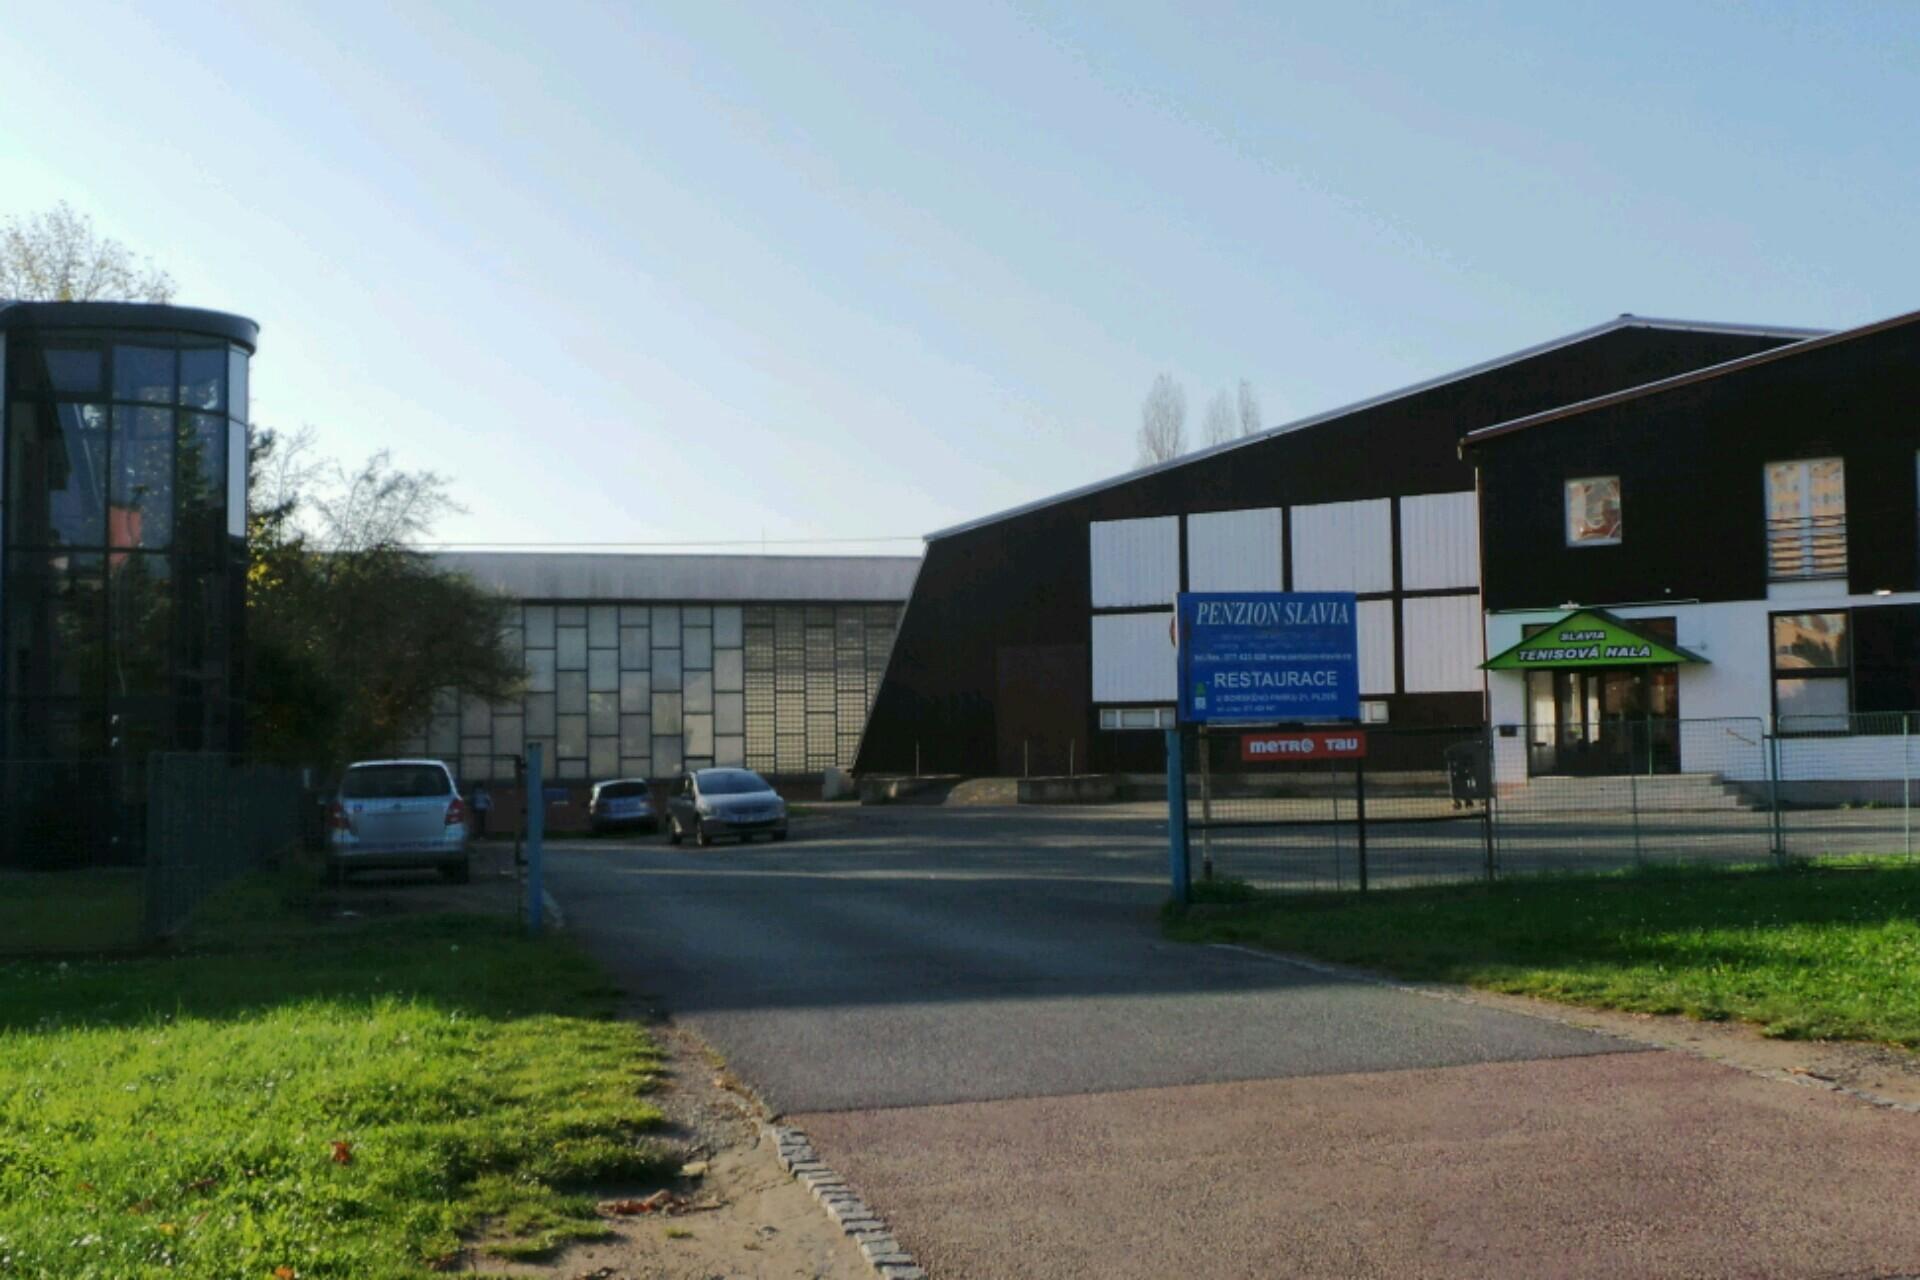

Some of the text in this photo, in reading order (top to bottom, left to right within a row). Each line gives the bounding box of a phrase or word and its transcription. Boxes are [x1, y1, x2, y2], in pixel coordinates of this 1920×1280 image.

[1195, 601, 1350, 626] PENZION SLAVIA
[1559, 631, 1606, 641] SLAVIA
[1518, 644, 1651, 661] TENISOVÁ HALA
[1213, 671, 1339, 688] RESTAURACE
